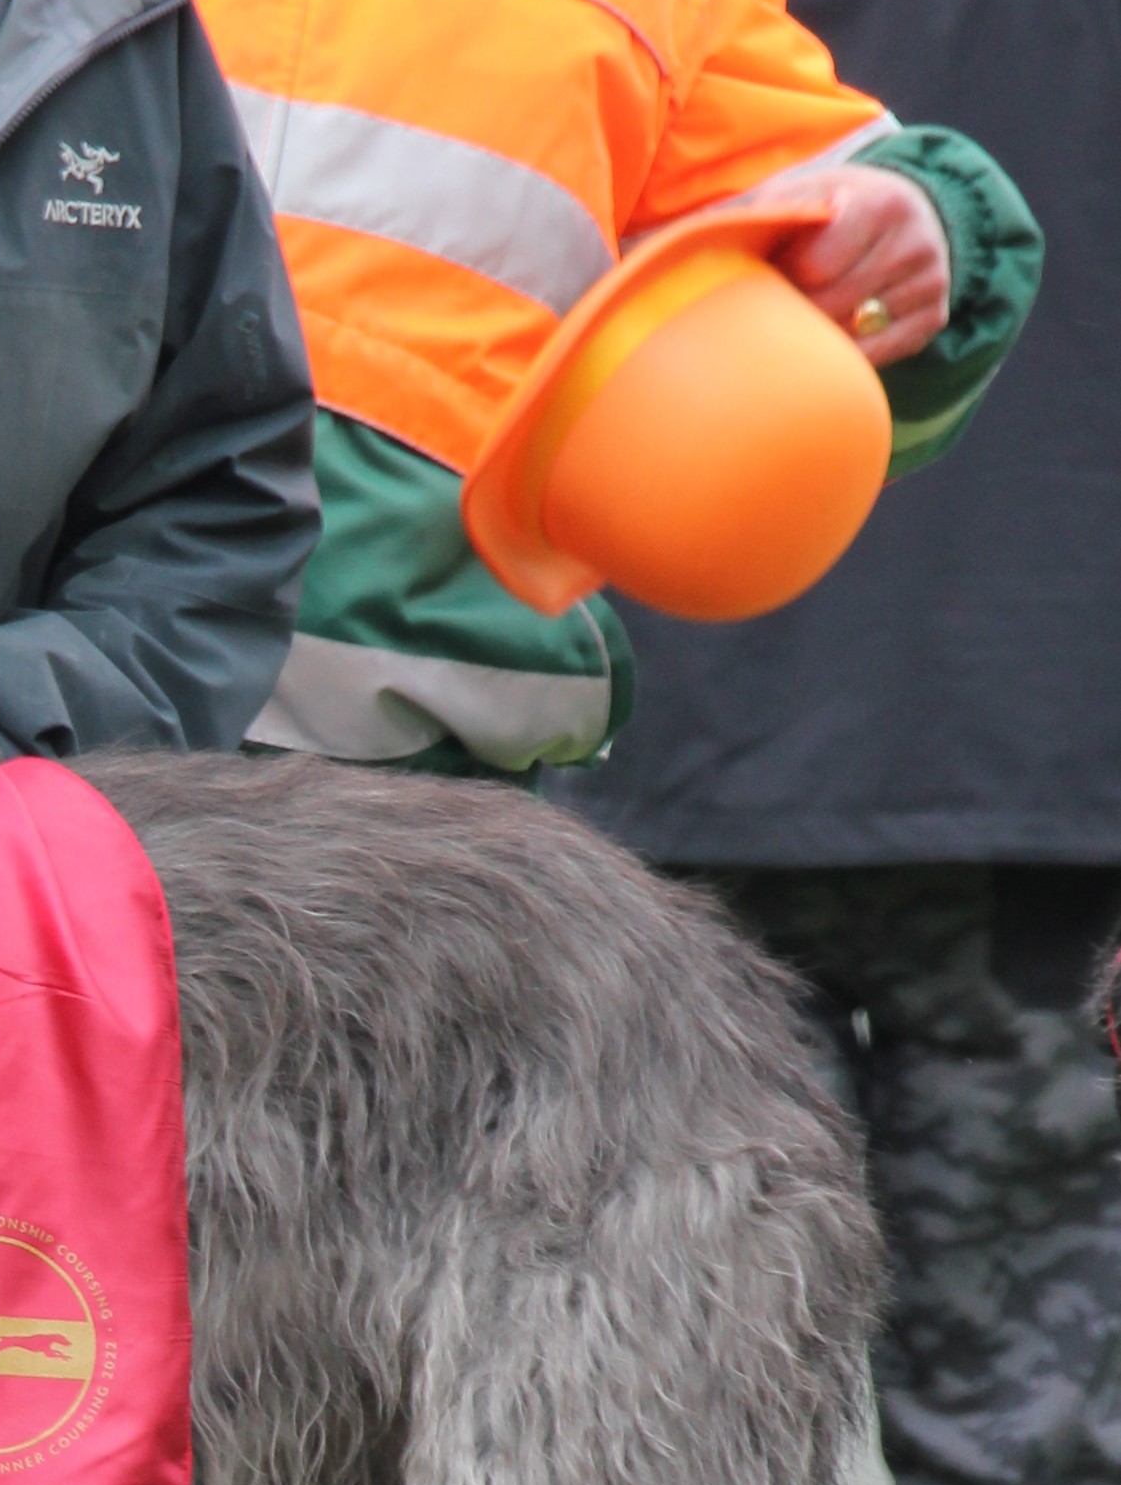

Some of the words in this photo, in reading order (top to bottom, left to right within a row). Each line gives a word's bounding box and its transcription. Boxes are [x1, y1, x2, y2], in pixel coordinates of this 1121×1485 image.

[56, 1244, 113, 1320] COURSING
[48, 1385, 109, 1455] COURSING
[101, 1341, 118, 1380] 2022
